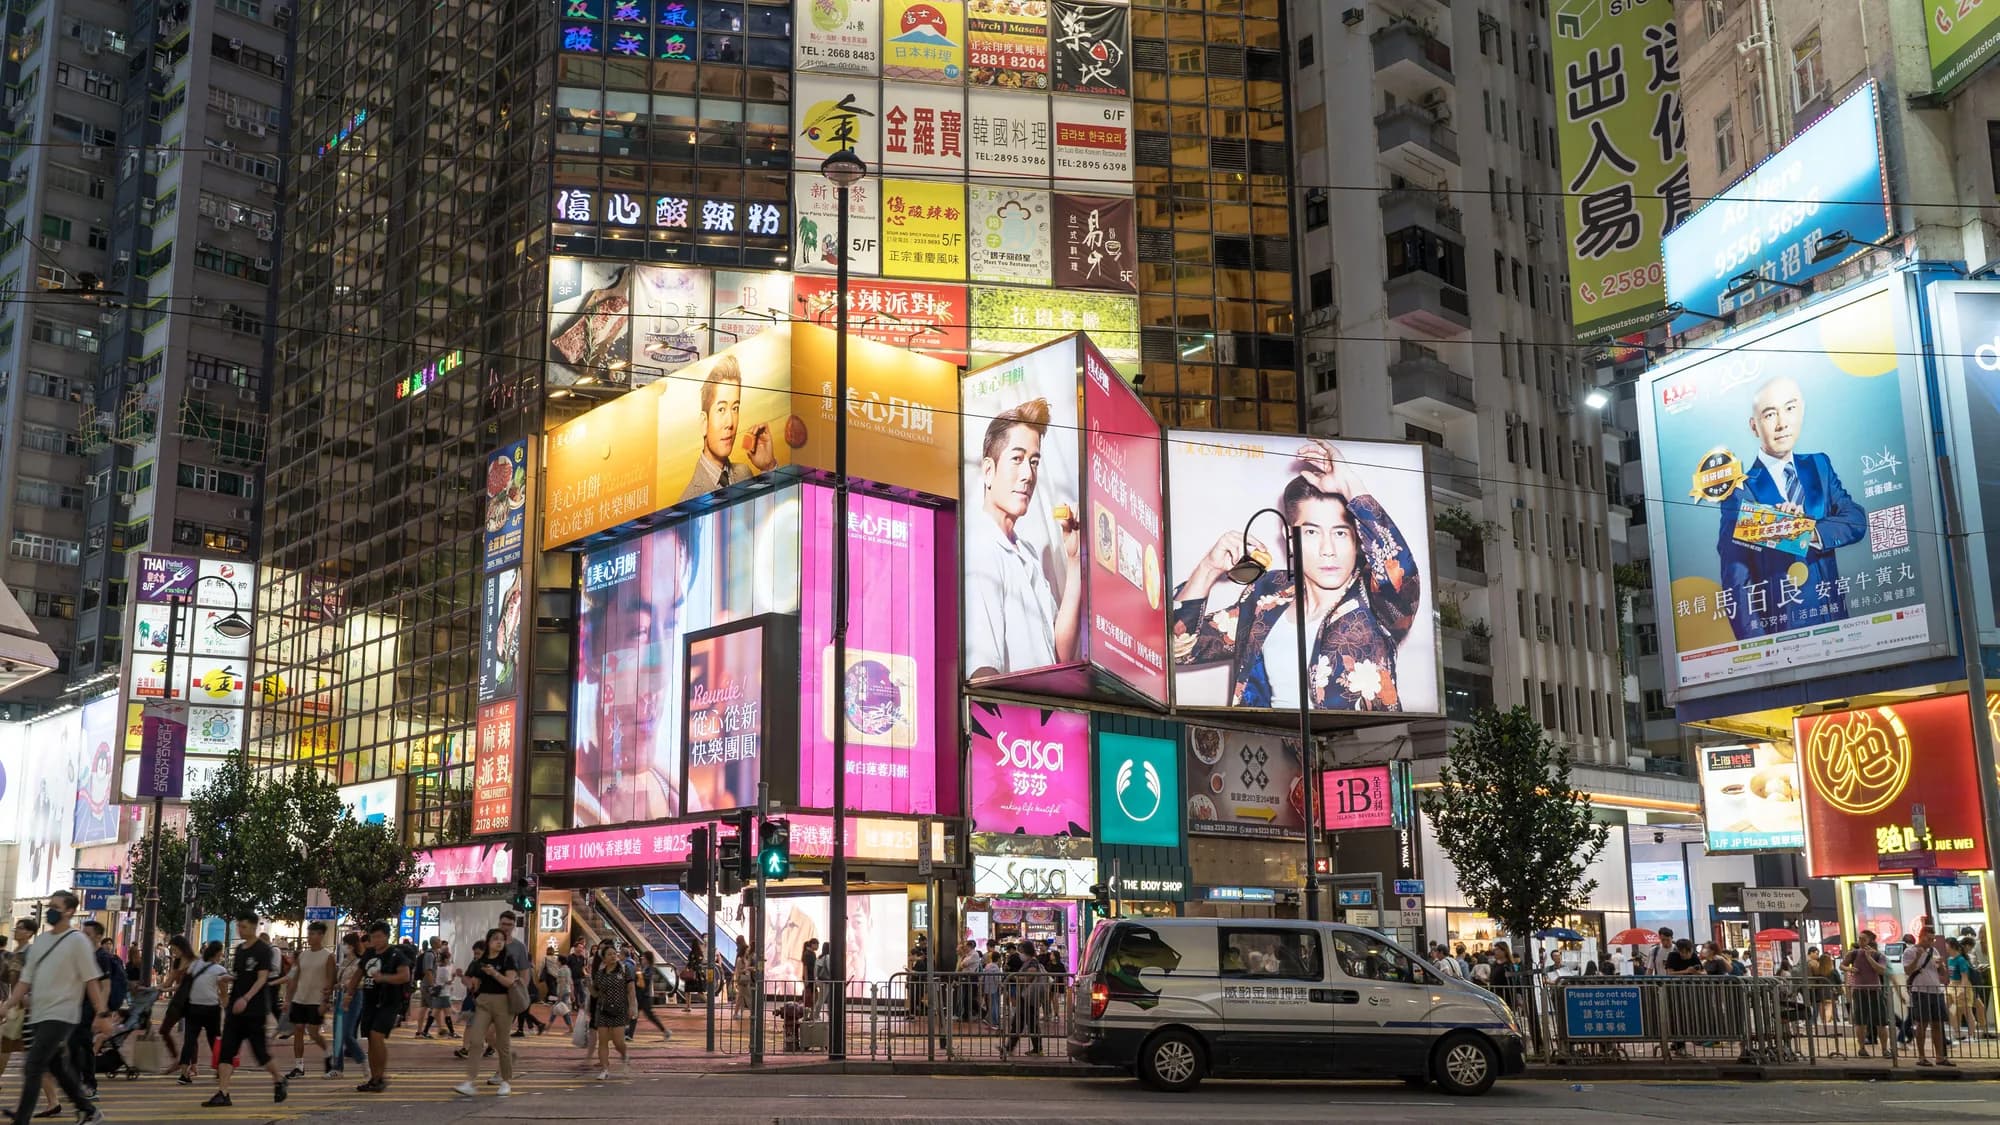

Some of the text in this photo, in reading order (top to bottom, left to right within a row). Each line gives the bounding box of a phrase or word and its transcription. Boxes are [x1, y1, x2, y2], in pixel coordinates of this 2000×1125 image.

[904, 10, 944, 25] 富士山
[1009, 24, 1045, 35] Masala
[801, 46, 875, 61] TEL 2668 8483
[895, 47, 952, 63] 日本料理
[971, 53, 1046, 69] 2881 8204
[1103, 109, 1125, 121] 6/F
[886, 105, 962, 158] 金羅寶
[972, 115, 1047, 149] 韓國料理
[1022, 155, 1046, 165] 3986
[1103, 161, 1127, 171] 6398
[908, 205, 960, 221] 酸辣粉
[852, 239, 876, 252] 5/F
[942, 233, 962, 246] 5/F
[1714, 229, 1762, 280] 9556
[1120, 270, 1133, 282] 5F
[558, 286, 573, 296] 3F
[821, 381, 833, 411] 香港
[846, 387, 934, 434] 美心月餅
[550, 472, 601, 514] 美心月餅
[1872, 545, 1911, 560] MADE IN HK
[143, 558, 166, 571] THAI
[592, 551, 637, 586] 美心月餅
[142, 582, 155, 591] 8/F
[1676, 562, 1915, 621] 我信 馬百良 安宮牛黃丸
[693, 672, 748, 706] Reunite!
[692, 700, 758, 738] 從心從新
[482, 720, 511, 753] 麻辣
[691, 733, 757, 767] 快樂團圓
[158, 723, 172, 793] HONG KONG
[481, 754, 511, 785] 派對
[1013, 771, 1048, 797] 莎莎
[1336, 777, 1372, 814] iB
[476, 819, 491, 830] 2178
[1730, 838, 1741, 848] JP
[1743, 836, 1769, 847] Plaza
[1935, 838, 1974, 851] JUE WEI
[1401, 845, 1410, 868] WALK
[1123, 880, 1183, 892] THE BODY SHOP
[1757, 900, 1785, 909] 怡和街
[1568, 991, 1593, 999] Please
[1621, 991, 1637, 999] stop
[1583, 1009, 1625, 1019] 請勿在此
